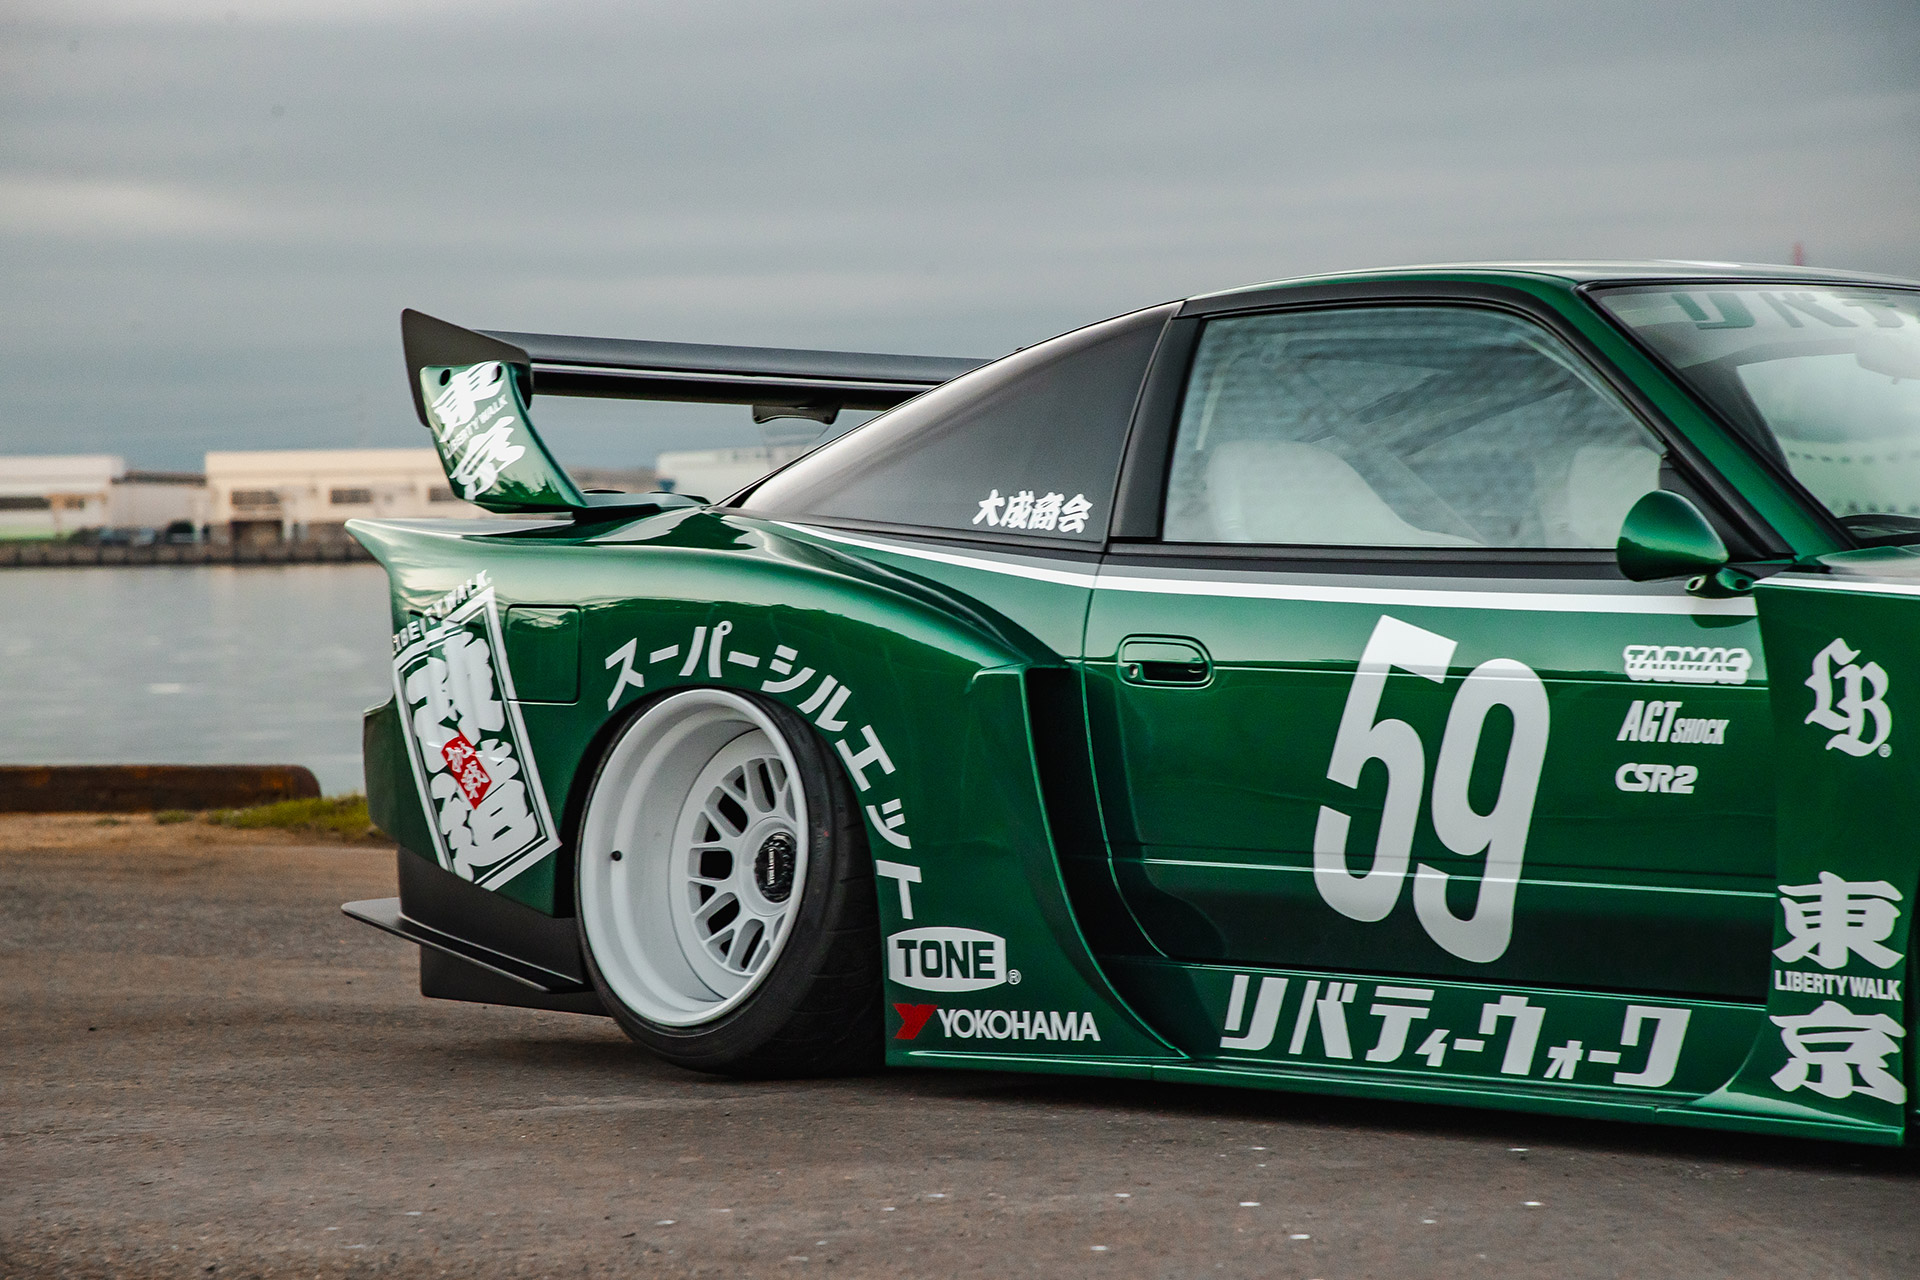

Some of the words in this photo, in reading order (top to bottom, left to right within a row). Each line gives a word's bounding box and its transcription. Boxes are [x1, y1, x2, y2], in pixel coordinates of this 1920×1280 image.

[478, 394, 508, 424] WALK
[1626, 648, 1747, 677] TARMAC
[1616, 700, 1683, 743] AGT
[604, 620, 923, 920] スーパーシルエット
[1313, 614, 1551, 963] 59
[1615, 762, 1699, 794] CSR2
[1771, 870, 1905, 970] 東
[897, 938, 996, 980] TONE
[1774, 969, 1850, 997] LIBERTY
[1848, 974, 1902, 1001] WALK
[936, 1008, 1102, 1042] YOKOHAMA
[1219, 974, 1692, 1088] リバティーウォーク
[1768, 1000, 1908, 1105] 京
